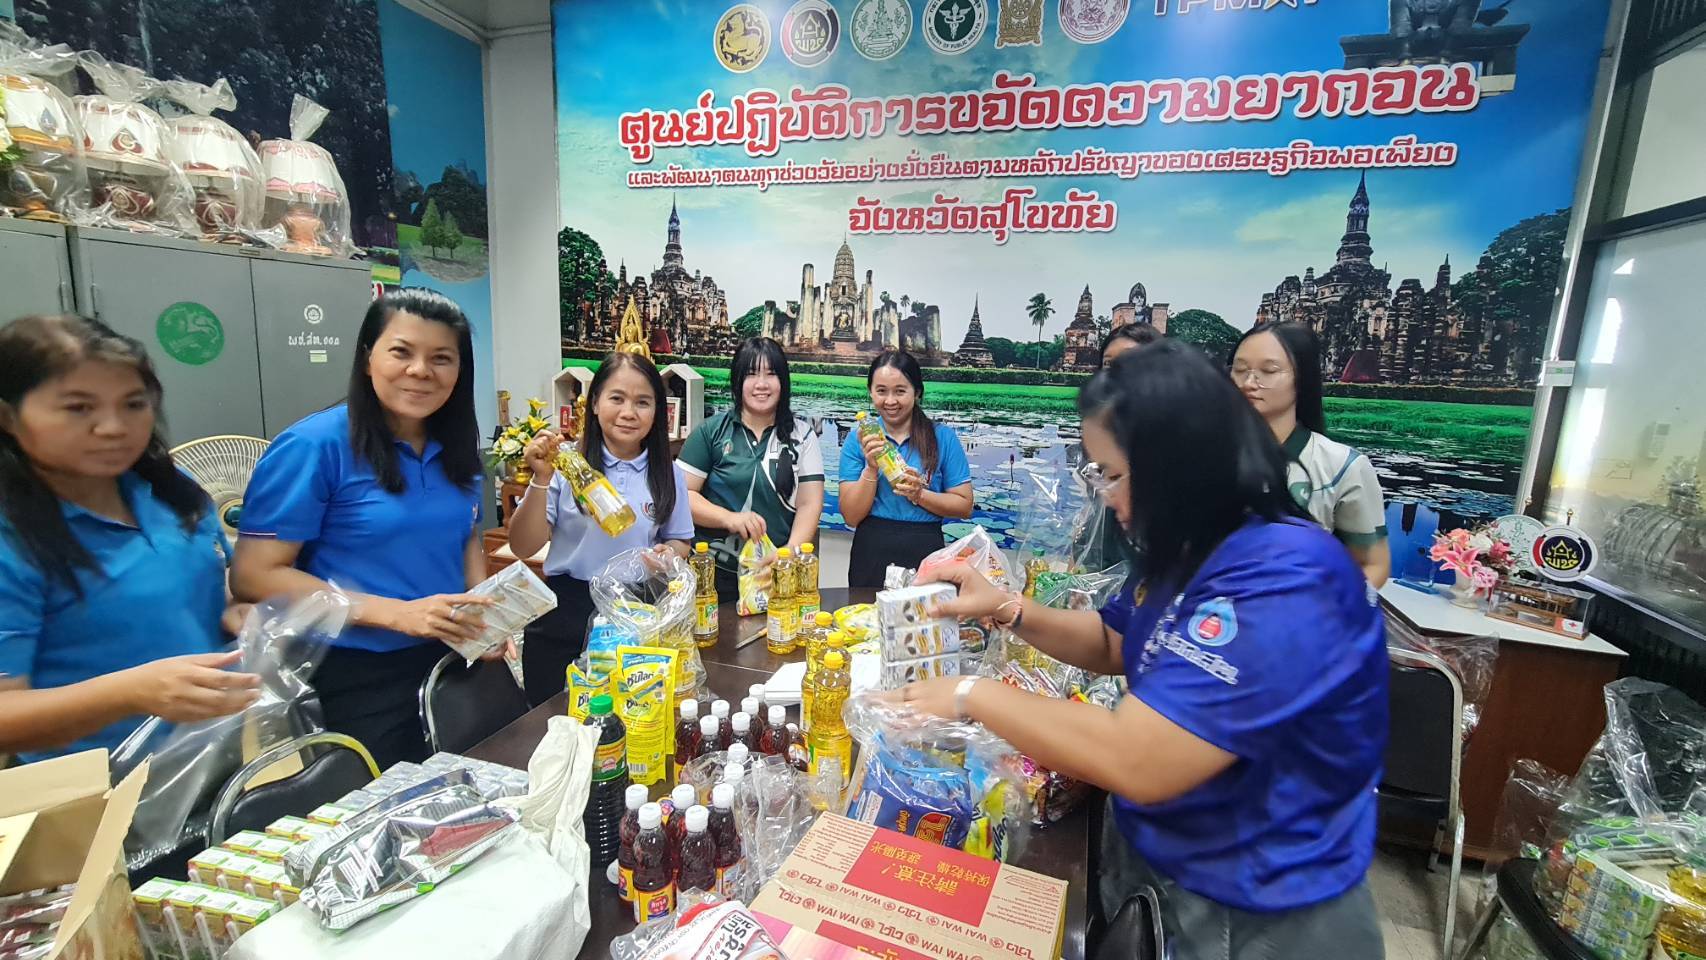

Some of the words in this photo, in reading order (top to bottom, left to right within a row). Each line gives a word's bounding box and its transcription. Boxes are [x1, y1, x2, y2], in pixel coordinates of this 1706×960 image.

[620, 66, 1476, 160] ศูนย์ปฏิบัติการขจัดความยากจน
[849, 189, 1115, 242] จังหวัดสุโขทัย
[800, 873, 823, 888] ไวไว
[840, 886, 859, 899] WAI
[861, 893, 881, 906] WAI
[897, 906, 923, 922] ไวไว
[779, 887, 802, 905] ไวไว
[816, 904, 837, 917] WAI
[839, 911, 860, 926] WAI
[878, 921, 904, 940] ไวไว
[921, 939, 943, 954] WAI
[946, 948, 969, 960] WAI
[941, 920, 962, 934] WAI
[966, 927, 987, 942] WAI
